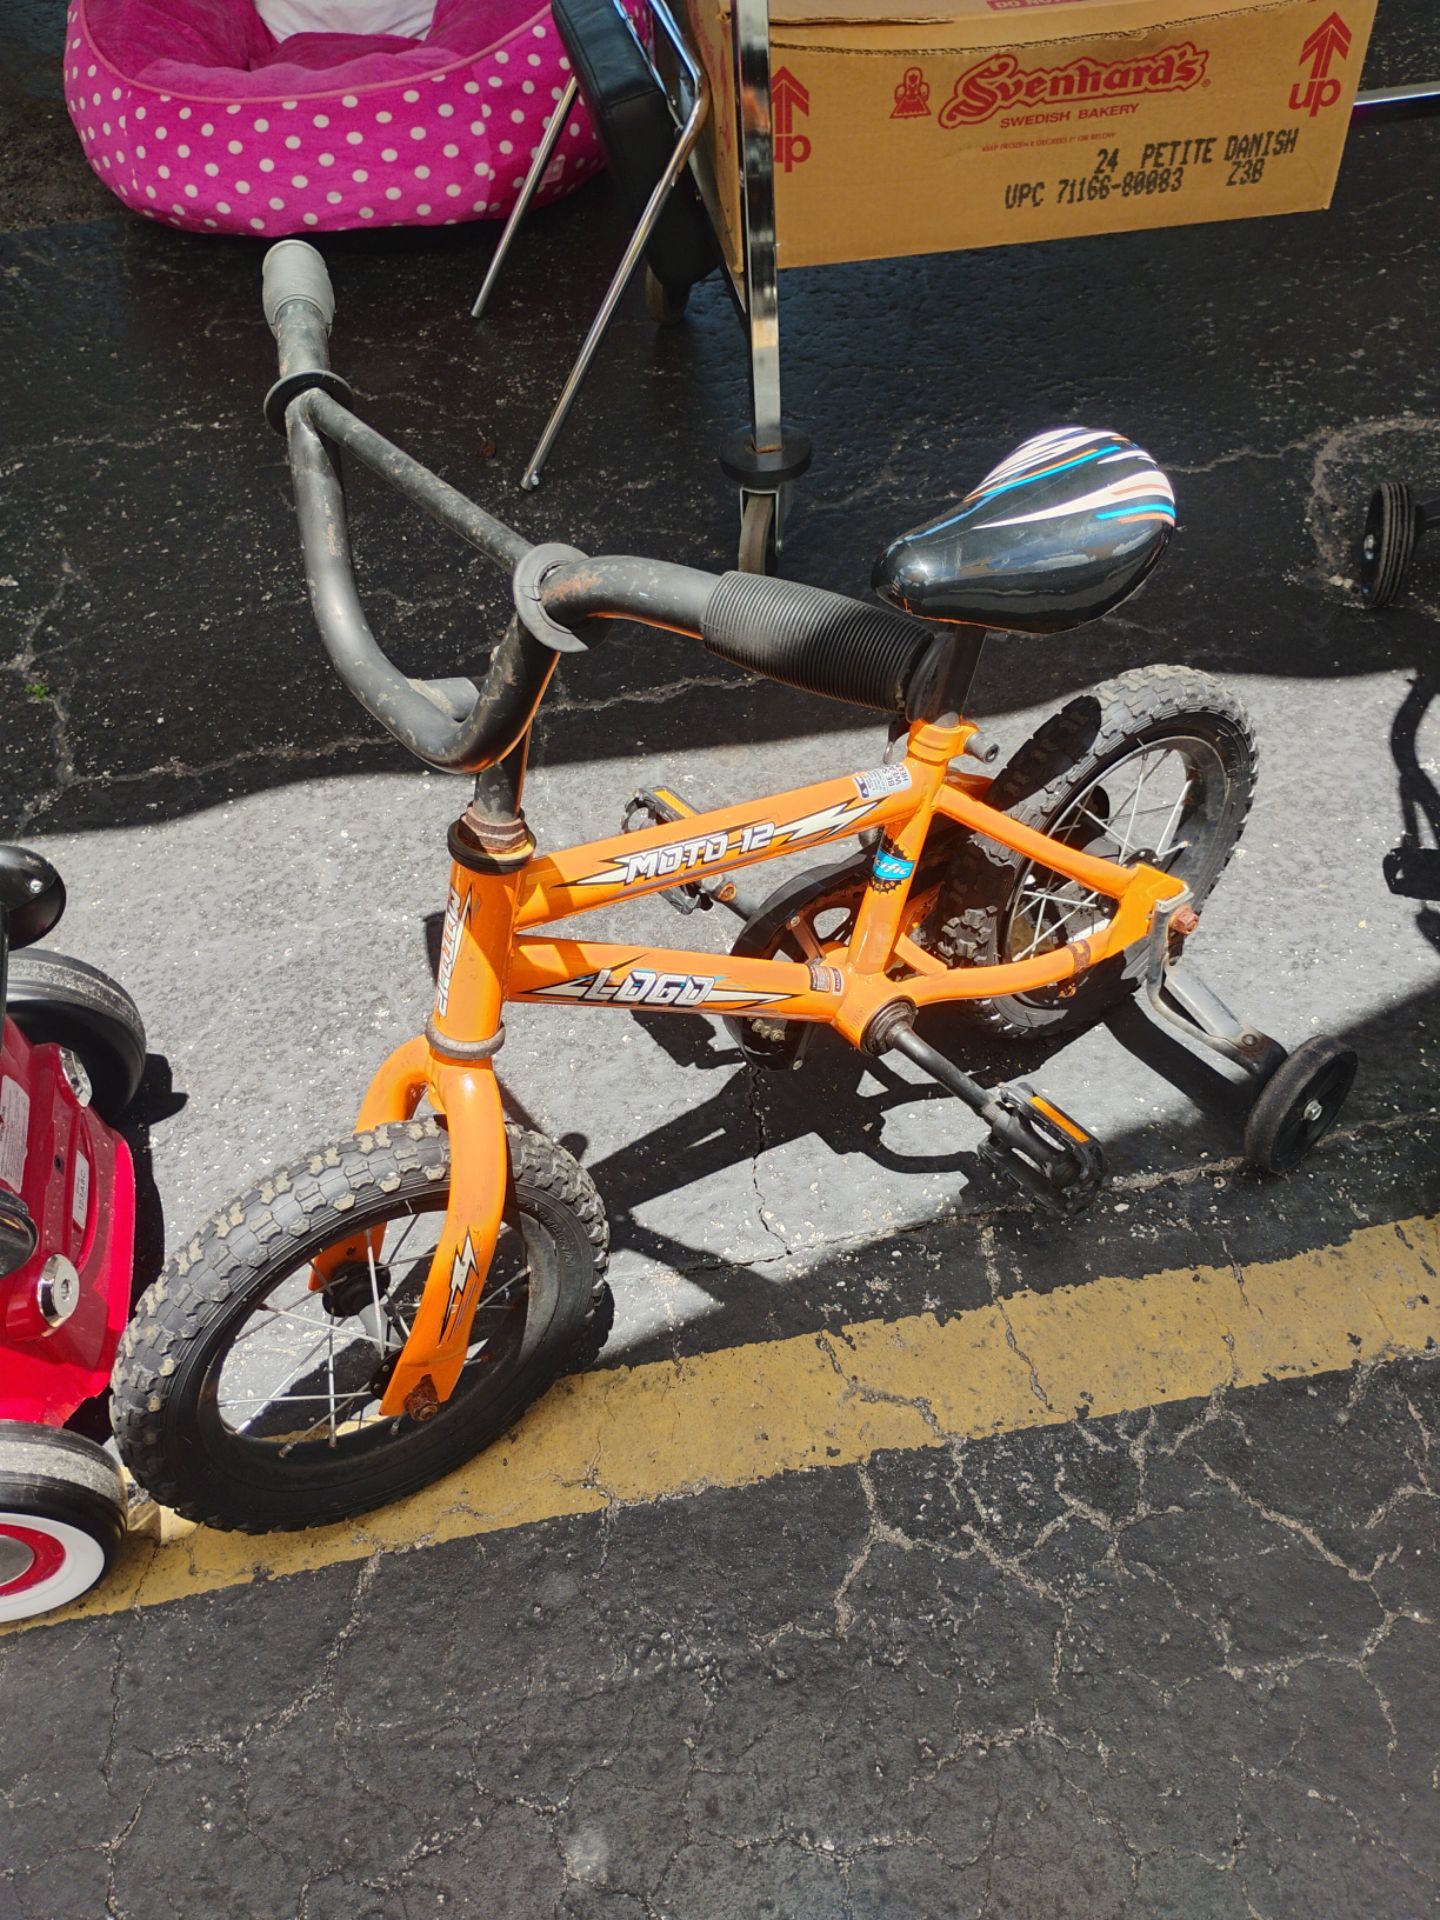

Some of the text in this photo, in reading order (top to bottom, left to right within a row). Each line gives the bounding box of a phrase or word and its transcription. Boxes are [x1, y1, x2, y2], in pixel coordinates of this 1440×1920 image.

[939, 42, 1208, 129] Svenhard's
[1288, 78, 1342, 118] up
[1000, 103, 1140, 129] SWEDISH BAKERY
[1094, 127, 1300, 173] 24 PETITE DANISH
[1005, 182, 1045, 209] UPC
[582, 968, 716, 1006] LOGO
